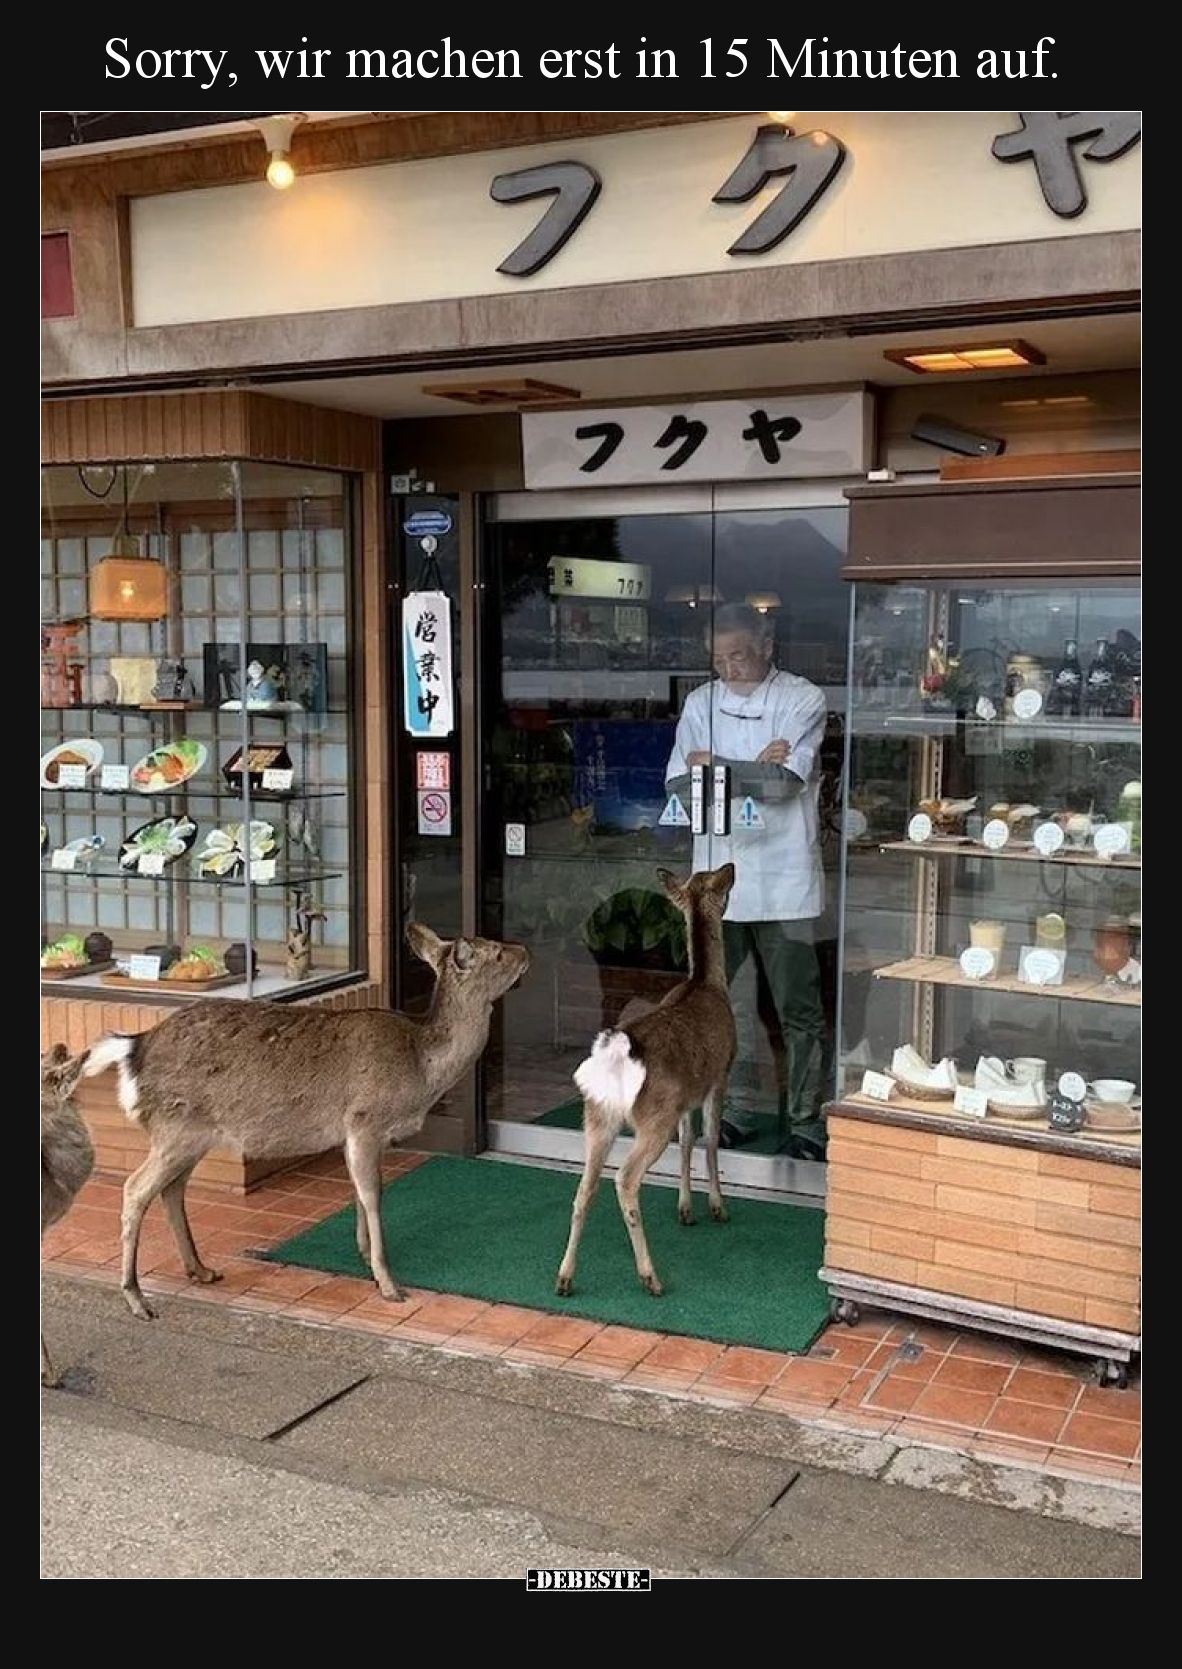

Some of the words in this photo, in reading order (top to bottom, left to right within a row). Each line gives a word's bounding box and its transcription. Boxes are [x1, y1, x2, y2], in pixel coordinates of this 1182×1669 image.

[489, 112, 1141, 277] フクヤ
[574, 409, 803, 473] フクヤ
[414, 611, 440, 725] 営業中
